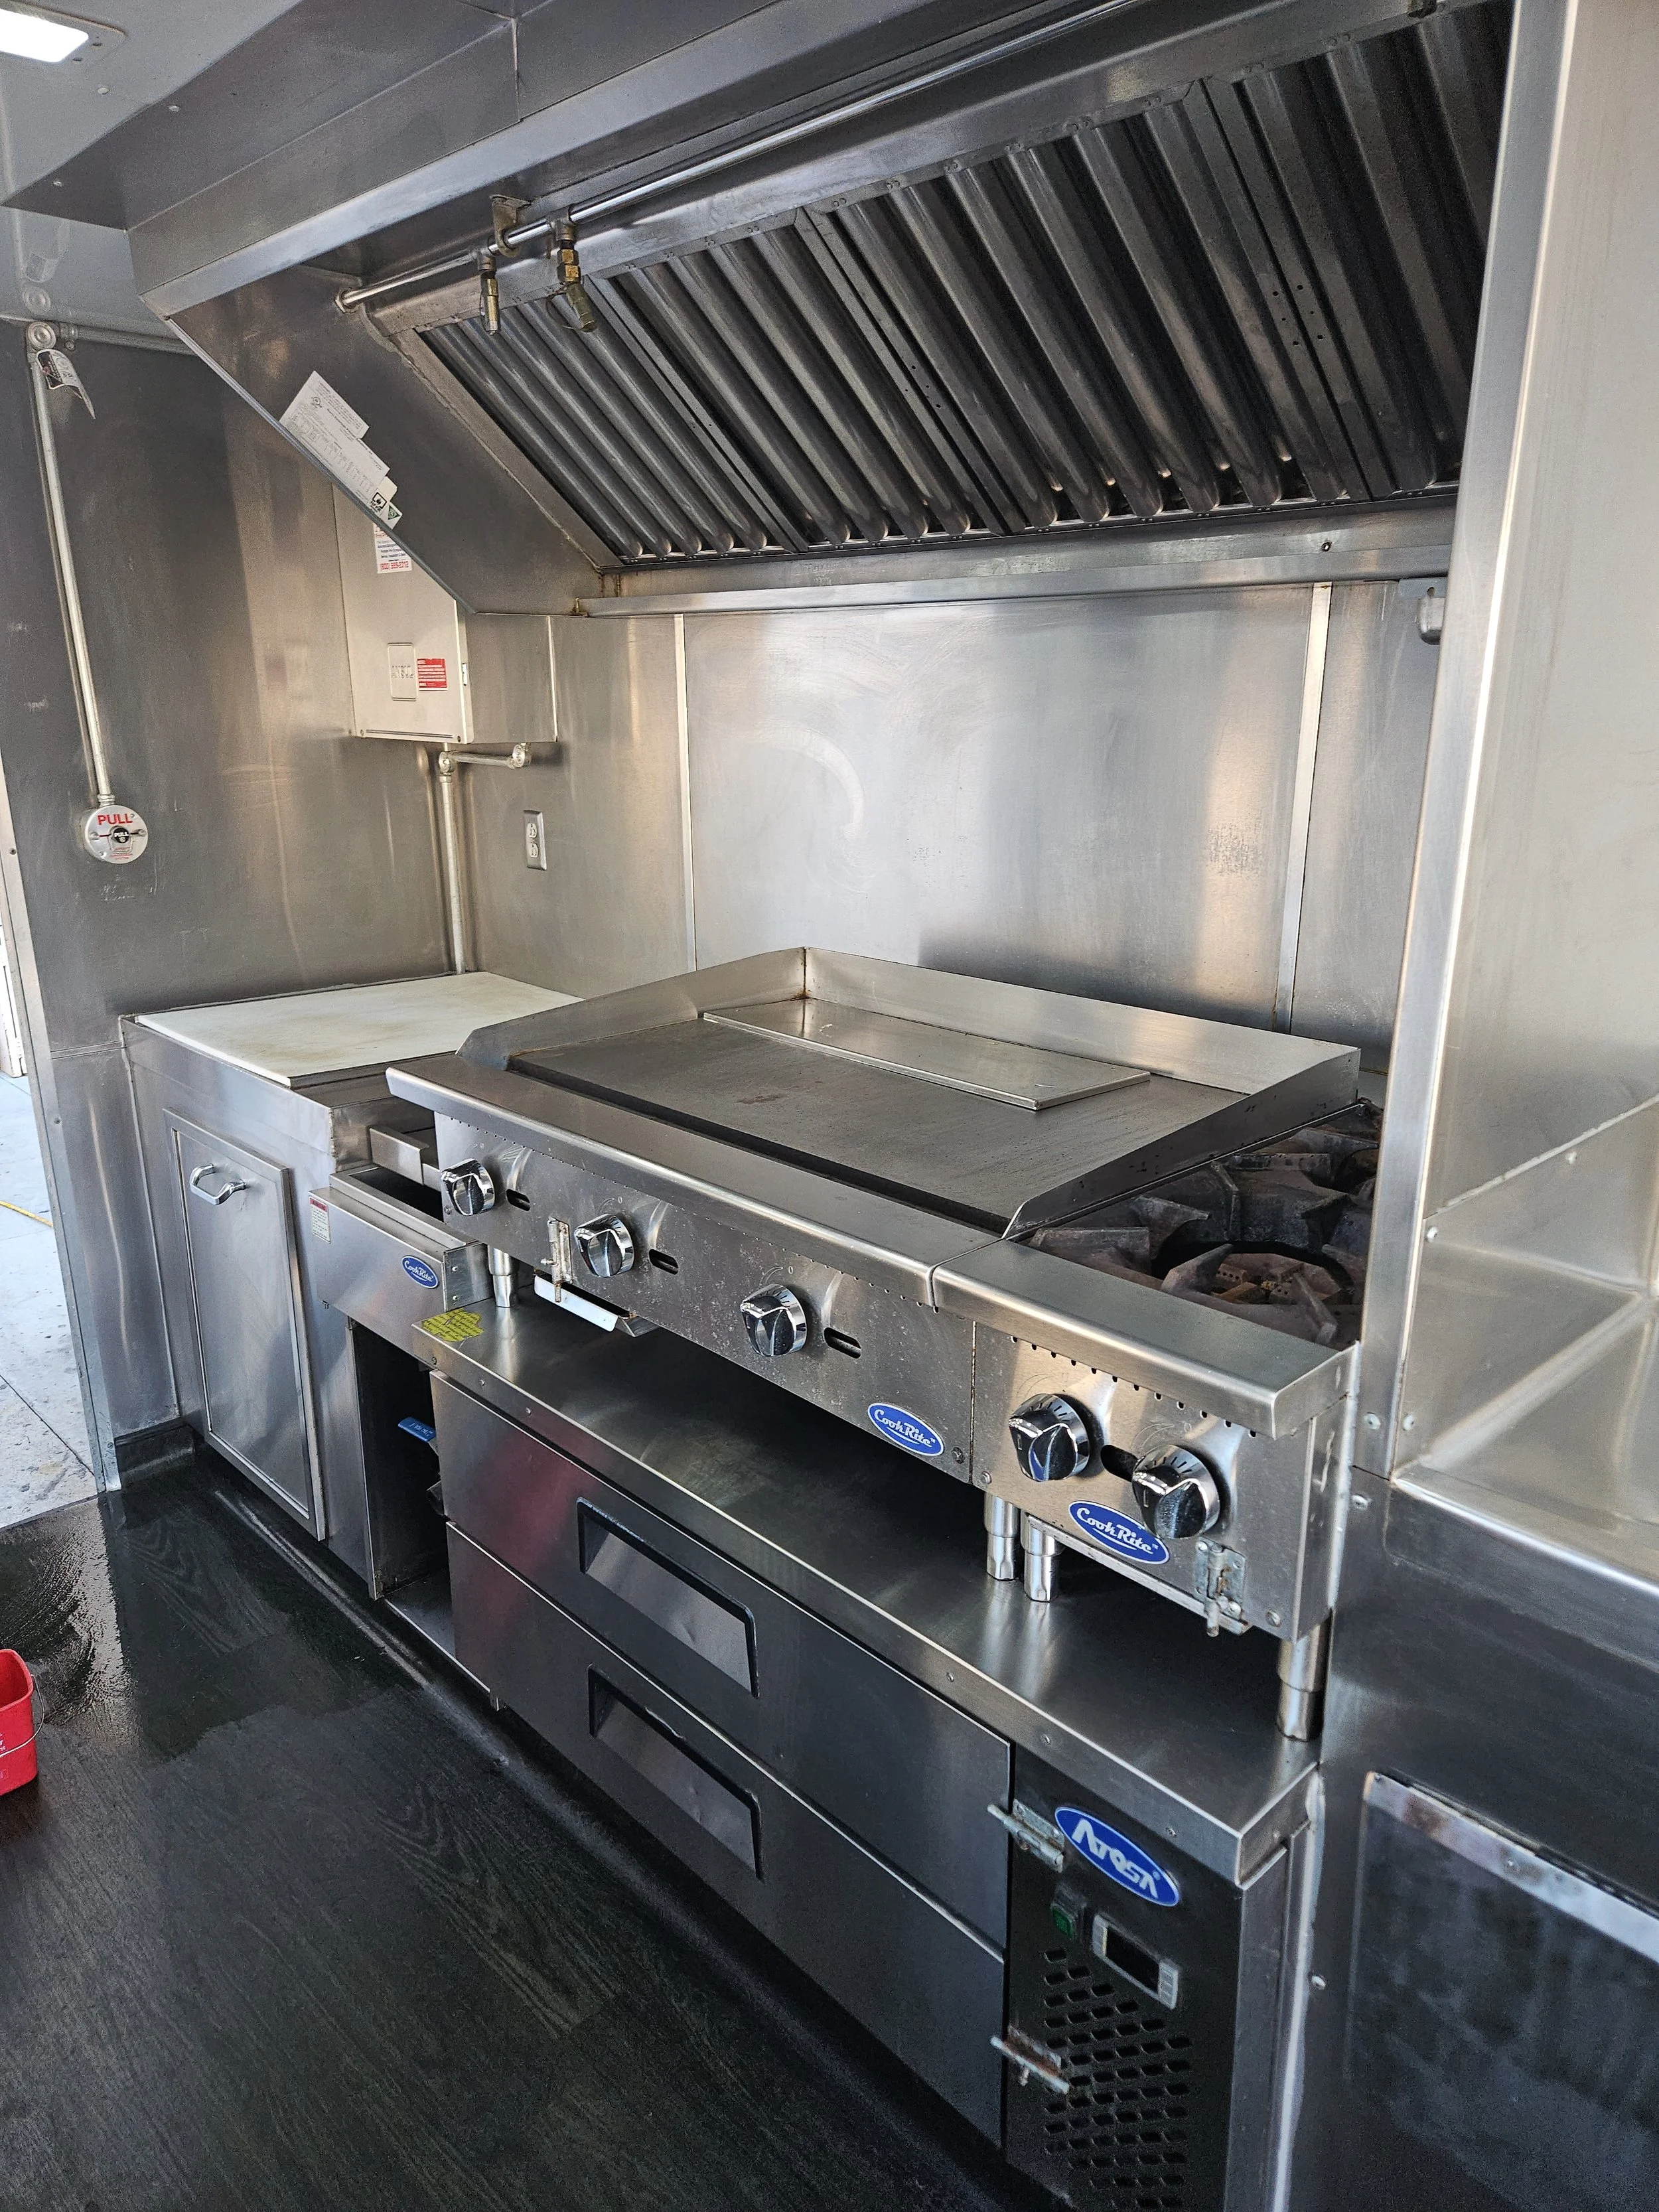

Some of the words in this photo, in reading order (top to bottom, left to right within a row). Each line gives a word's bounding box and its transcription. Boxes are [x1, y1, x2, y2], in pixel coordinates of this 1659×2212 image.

[97, 814, 133, 825] PULL
[404, 1260, 433, 1282] CookRite
[874, 1409, 932, 1447] CookRite
[1076, 1507, 1154, 1554] CookRite
[1071, 1818, 1159, 1899] ATOSA
